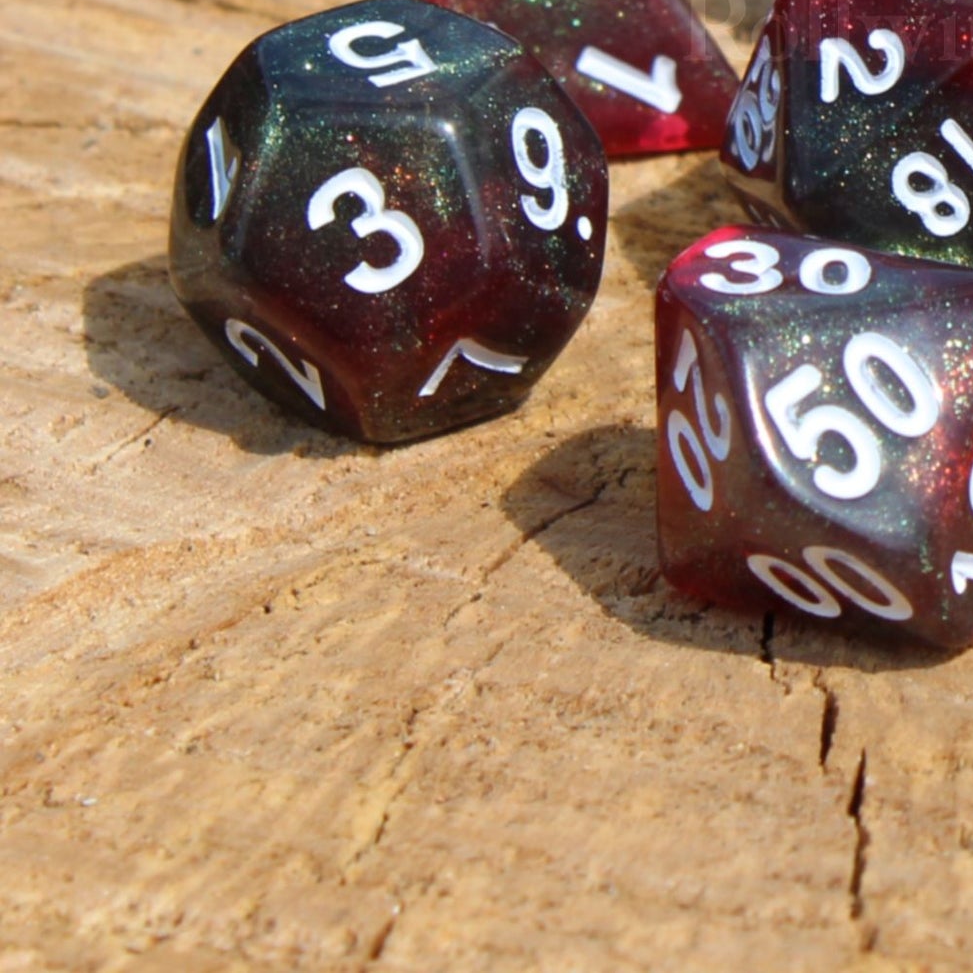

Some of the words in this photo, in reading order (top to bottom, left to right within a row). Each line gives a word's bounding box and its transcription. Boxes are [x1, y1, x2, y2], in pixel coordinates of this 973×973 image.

[327, 21, 439, 87] 5
[575, 47, 682, 114] 1
[820, 29, 904, 103] 2
[308, 168, 424, 294] 3
[700, 240, 871, 294] 30
[225, 319, 325, 410] 2
[765, 332, 939, 499] 50
[748, 546, 912, 621] 00
